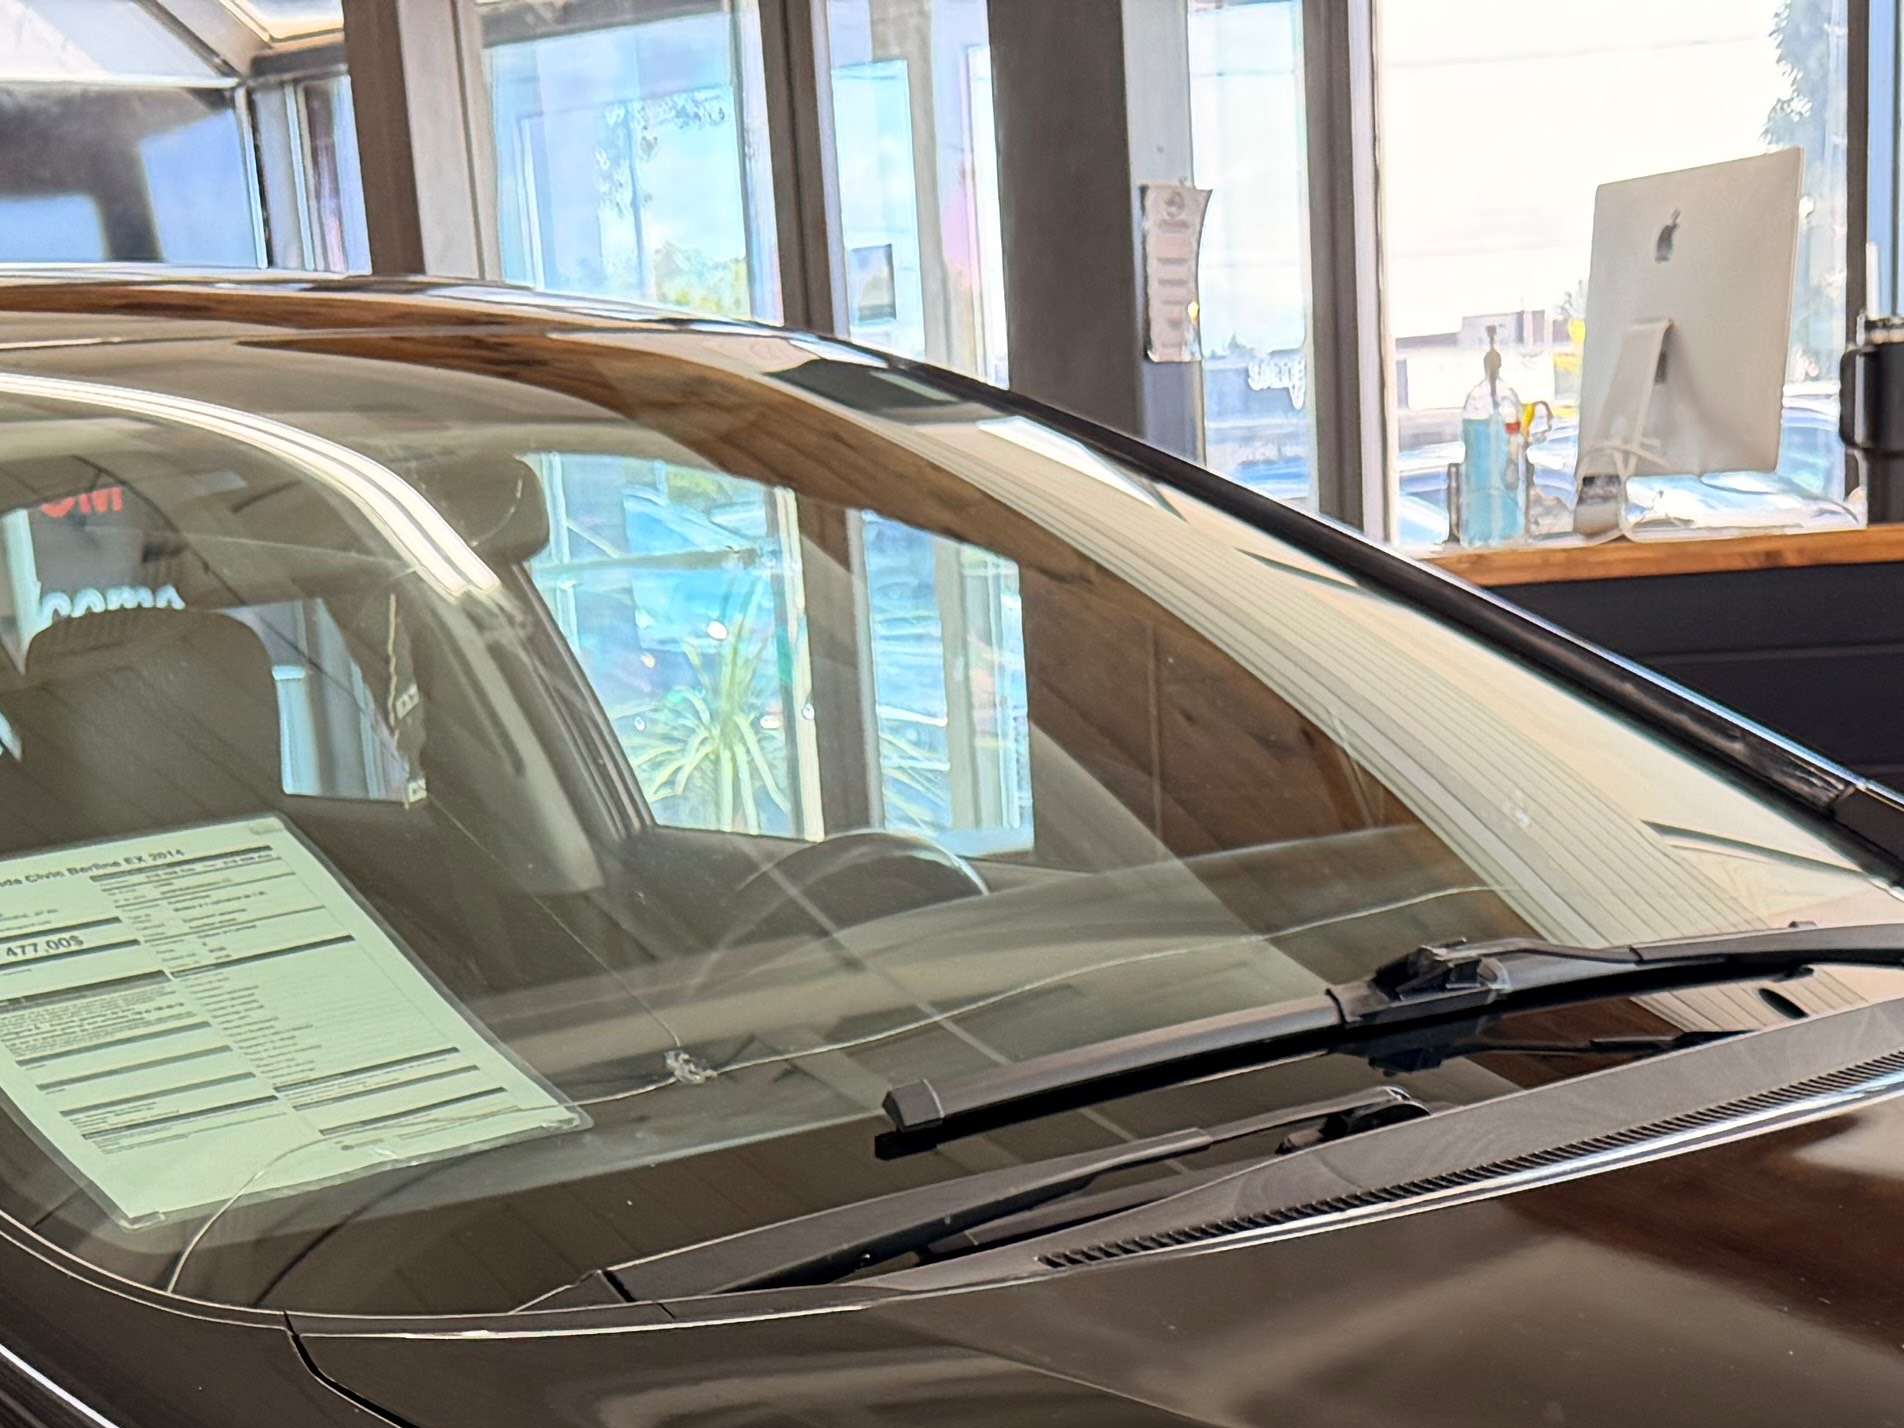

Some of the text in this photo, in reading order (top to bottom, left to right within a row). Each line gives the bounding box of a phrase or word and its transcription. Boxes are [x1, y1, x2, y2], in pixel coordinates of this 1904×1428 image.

[25, 869, 65, 884] Civic
[67, 859, 121, 876] Berline
[123, 854, 145, 866] EX
[149, 848, 186, 862] 2014
